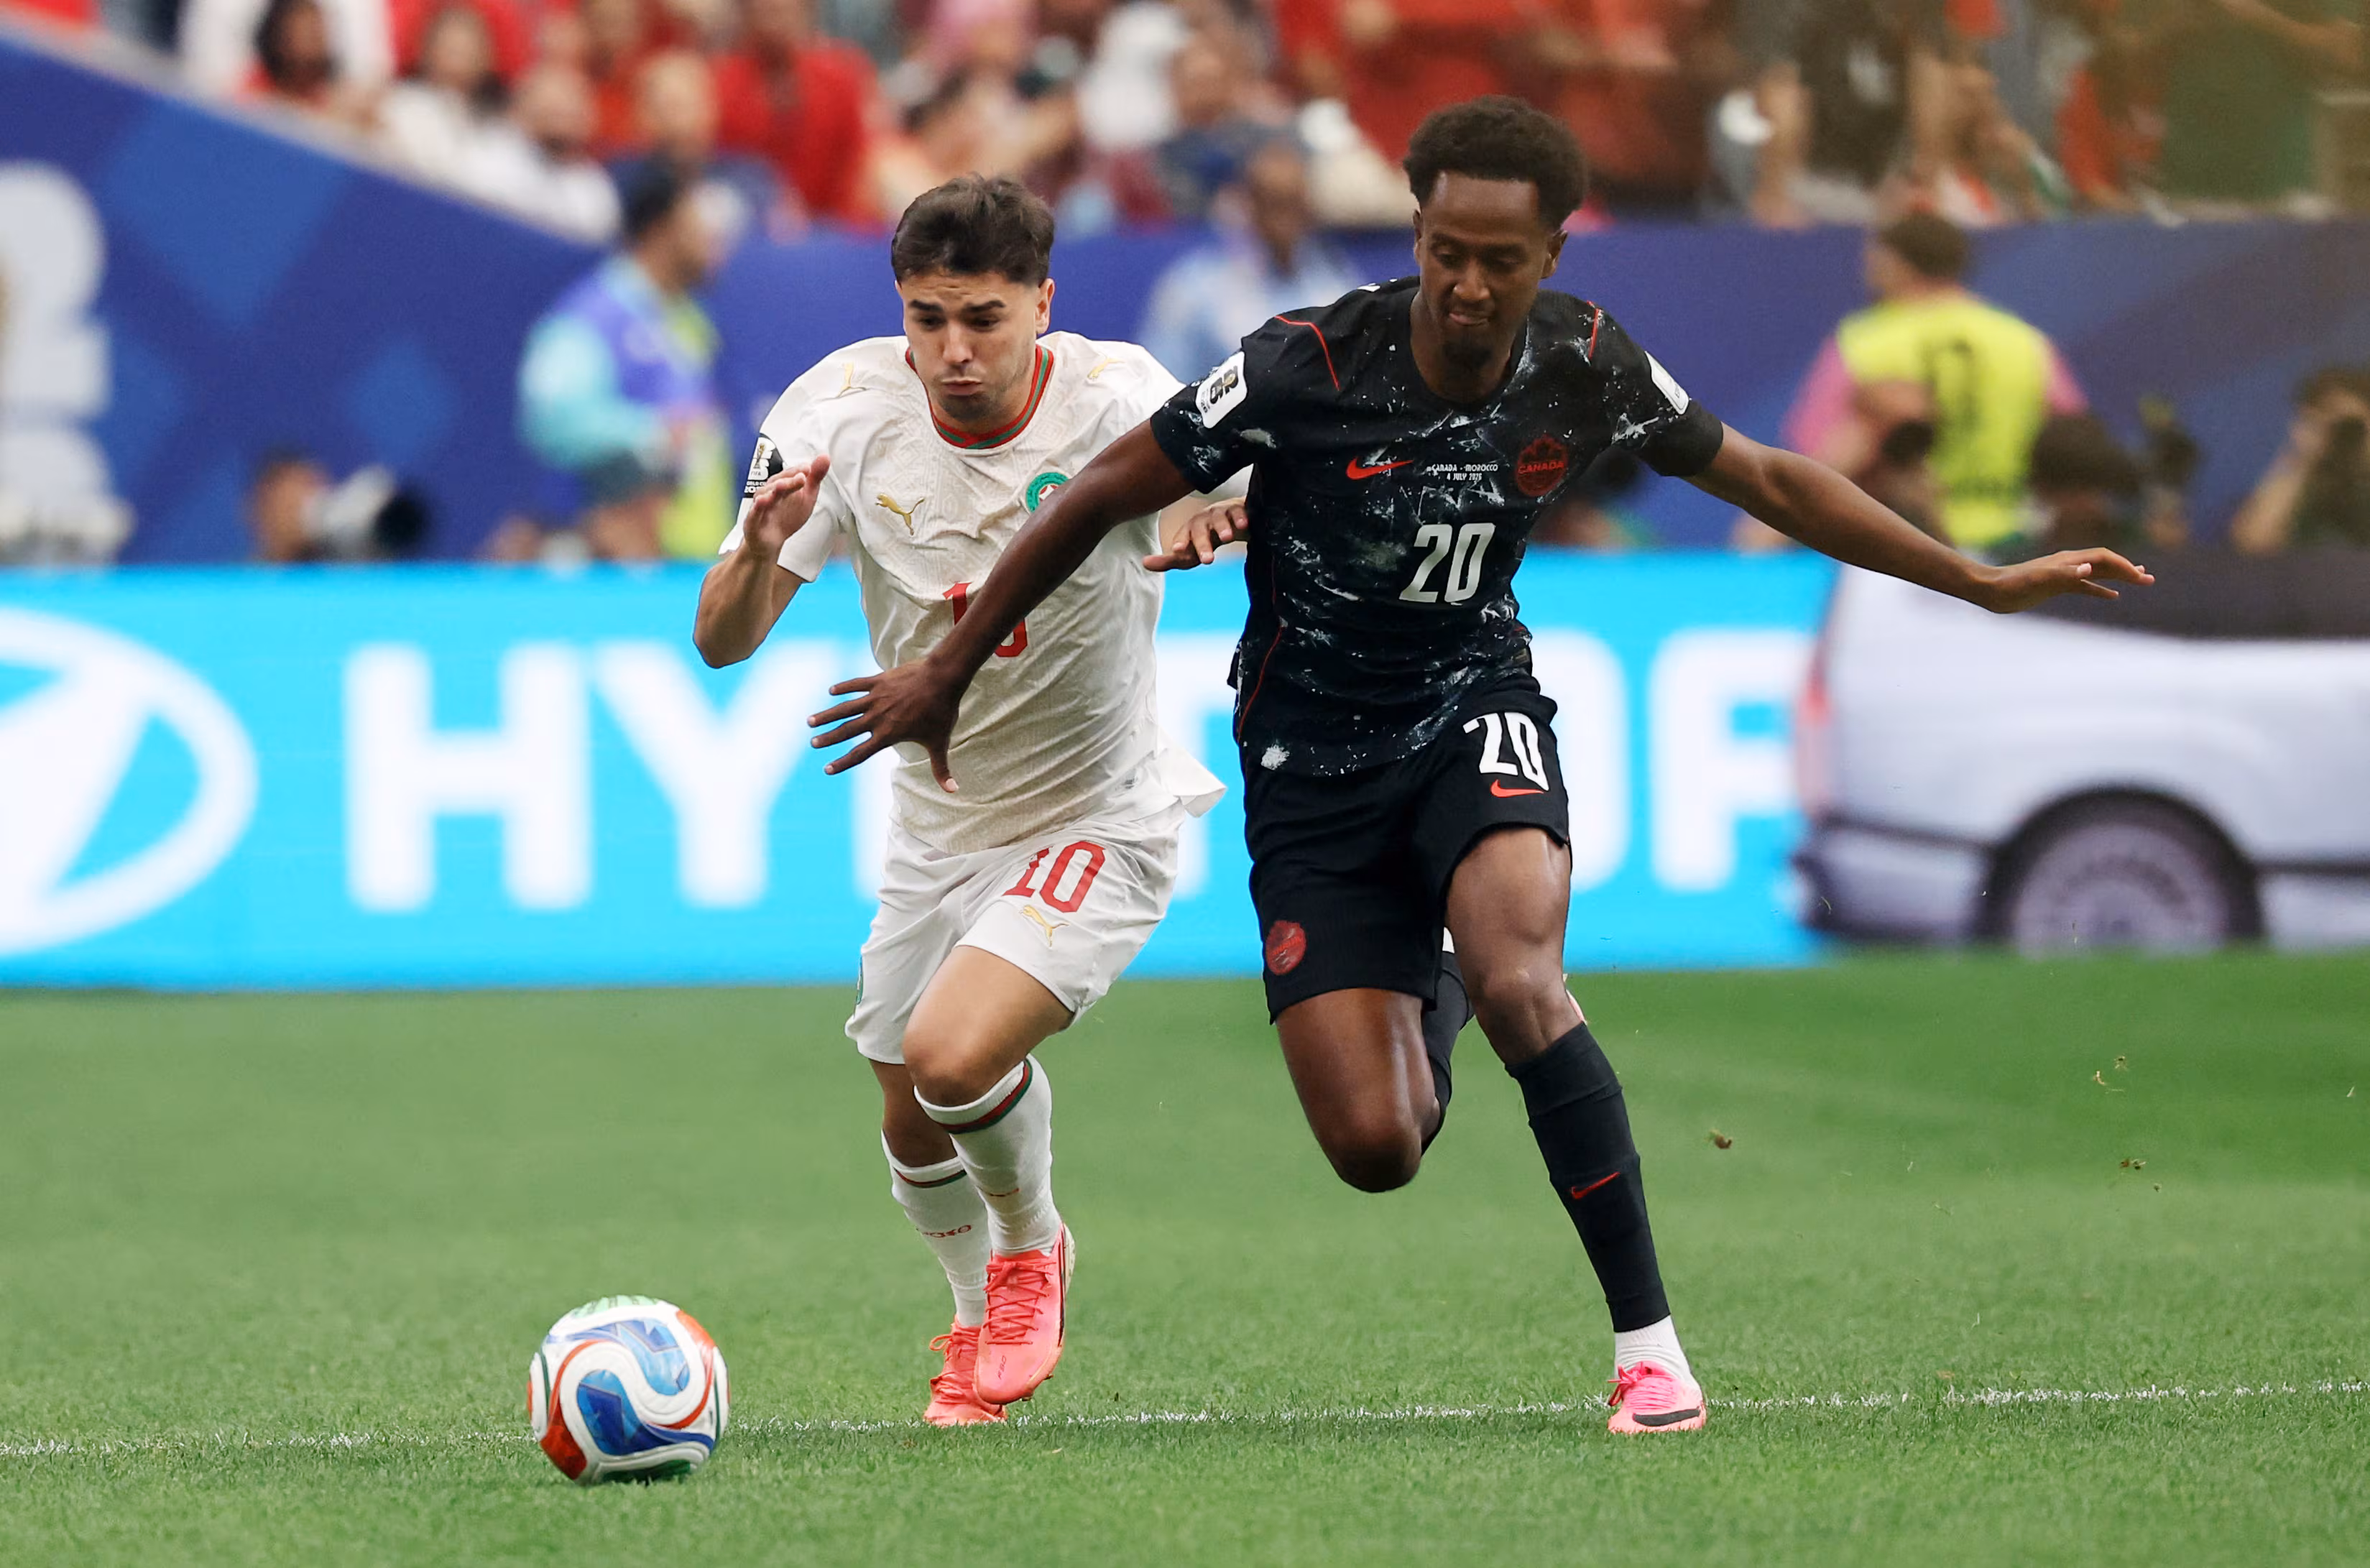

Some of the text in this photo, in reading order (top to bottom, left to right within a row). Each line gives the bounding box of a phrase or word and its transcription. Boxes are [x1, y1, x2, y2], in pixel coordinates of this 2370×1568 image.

[1518, 460, 1564, 474] CANADA
[1398, 522, 1496, 603] 20
[1462, 711, 1549, 791] 20
[1001, 840, 1106, 913] 10
